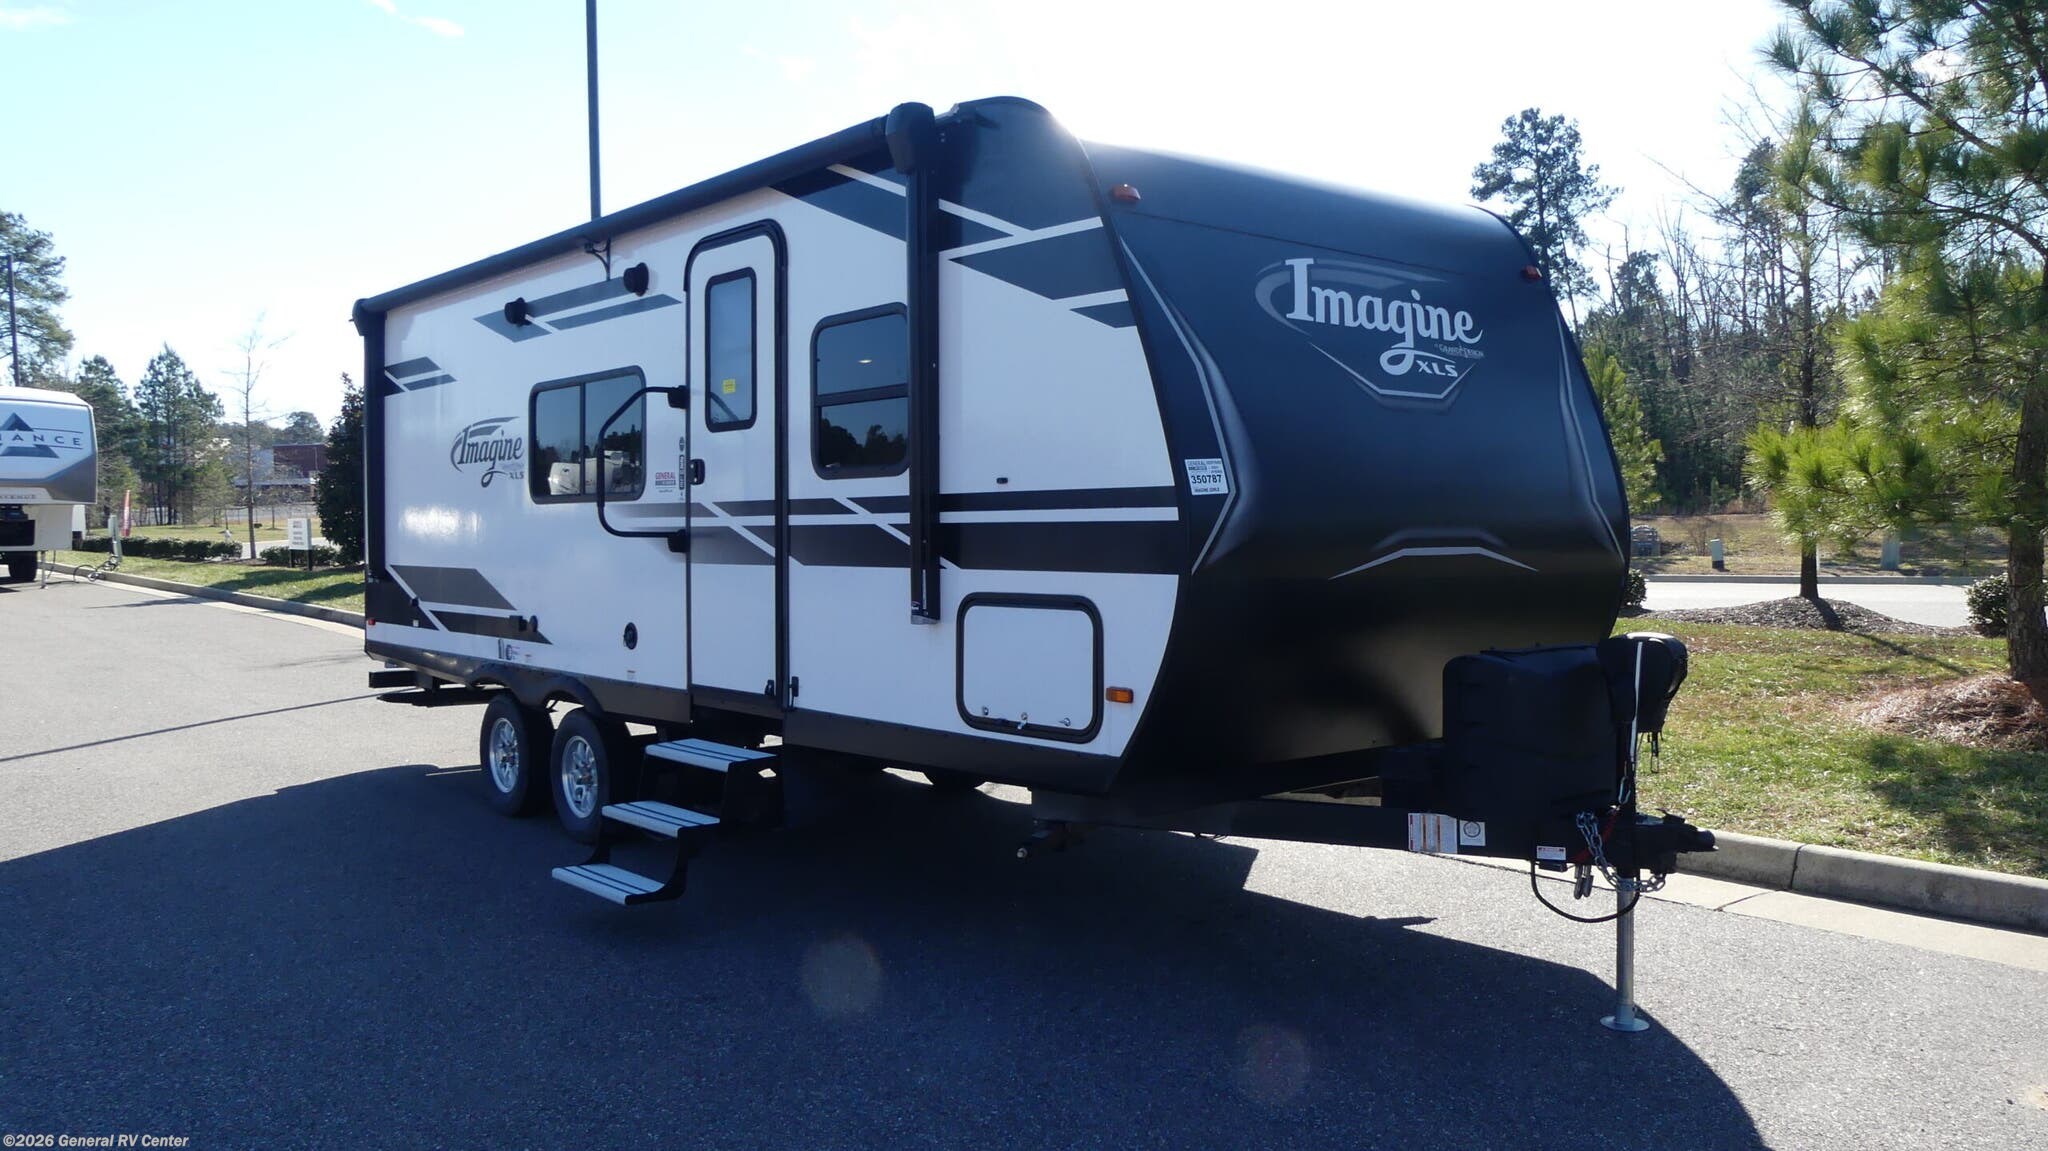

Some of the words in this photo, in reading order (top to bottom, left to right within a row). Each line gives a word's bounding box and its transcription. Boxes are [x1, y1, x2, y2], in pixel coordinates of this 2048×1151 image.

[1285, 258, 1484, 376] Imagine
[1415, 359, 1458, 377] XLS
[457, 424, 525, 488] Imagine
[508, 471, 525, 480] XLS
[1191, 474, 1222, 484] 350787
